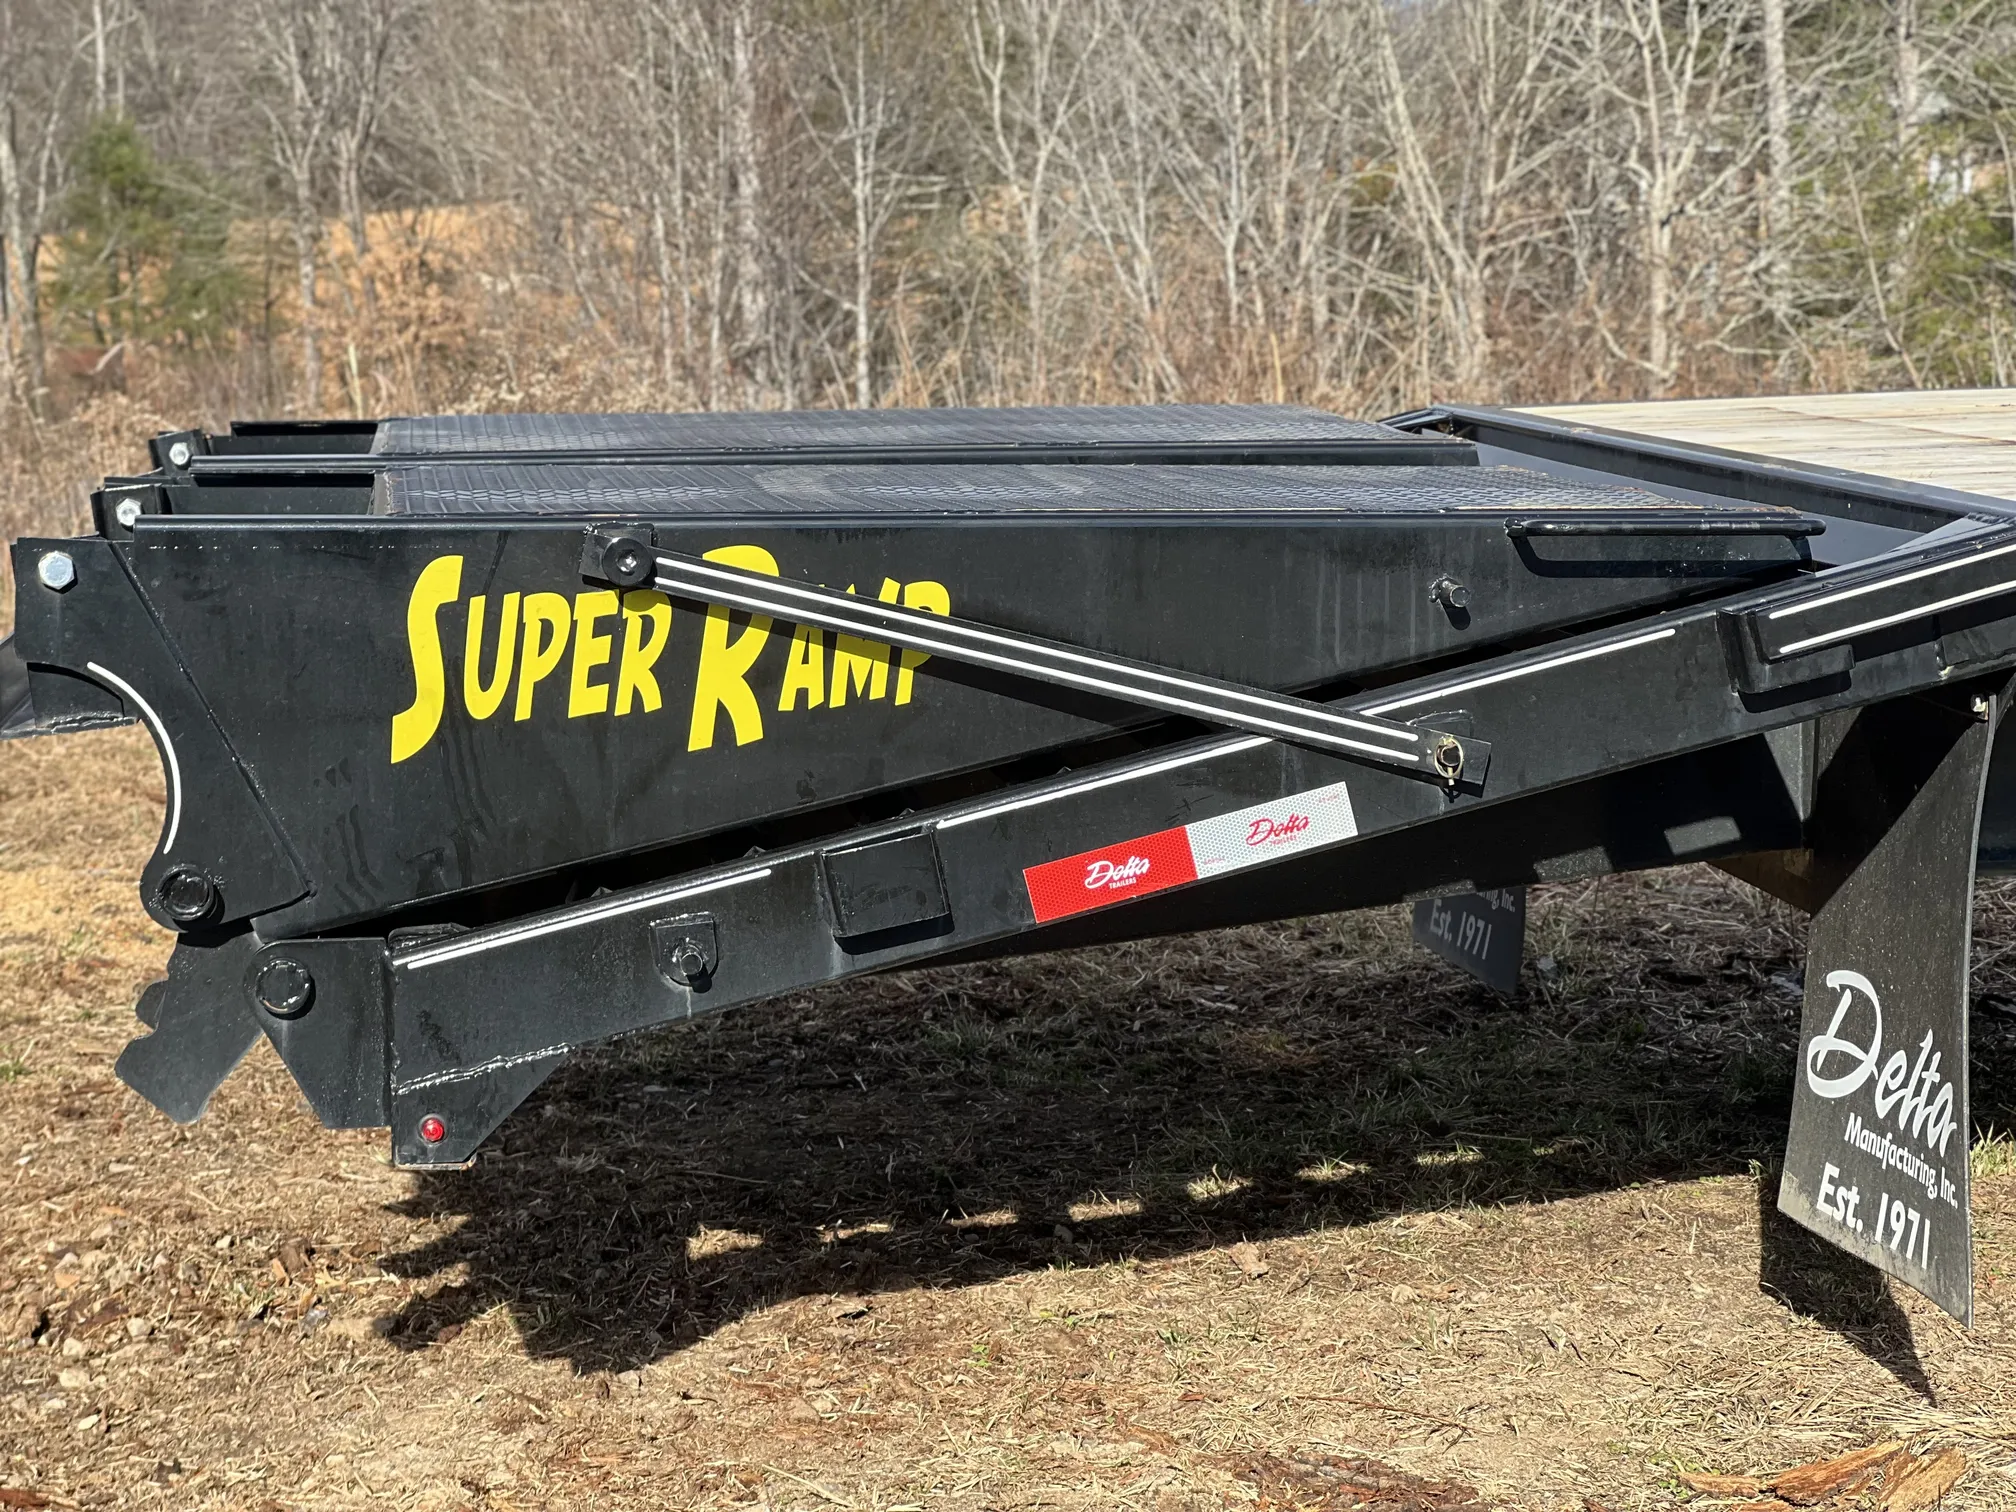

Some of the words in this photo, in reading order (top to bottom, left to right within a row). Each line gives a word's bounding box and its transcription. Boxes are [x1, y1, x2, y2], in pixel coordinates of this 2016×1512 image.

[391, 554, 672, 763] SUPER
[1246, 812, 1310, 846] Delta
[1084, 855, 1151, 889] Delta
[1108, 876, 1137, 889] TRAILERS
[1429, 898, 1452, 943] Est.
[1456, 910, 1493, 960] 1971
[1806, 969, 1958, 1158] Delta
[1843, 1111, 1938, 1200] Manufacturing,
[1939, 1166, 1959, 1210] Inc.
[1815, 1161, 1864, 1234] Est.
[1874, 1191, 1931, 1270] 1971
